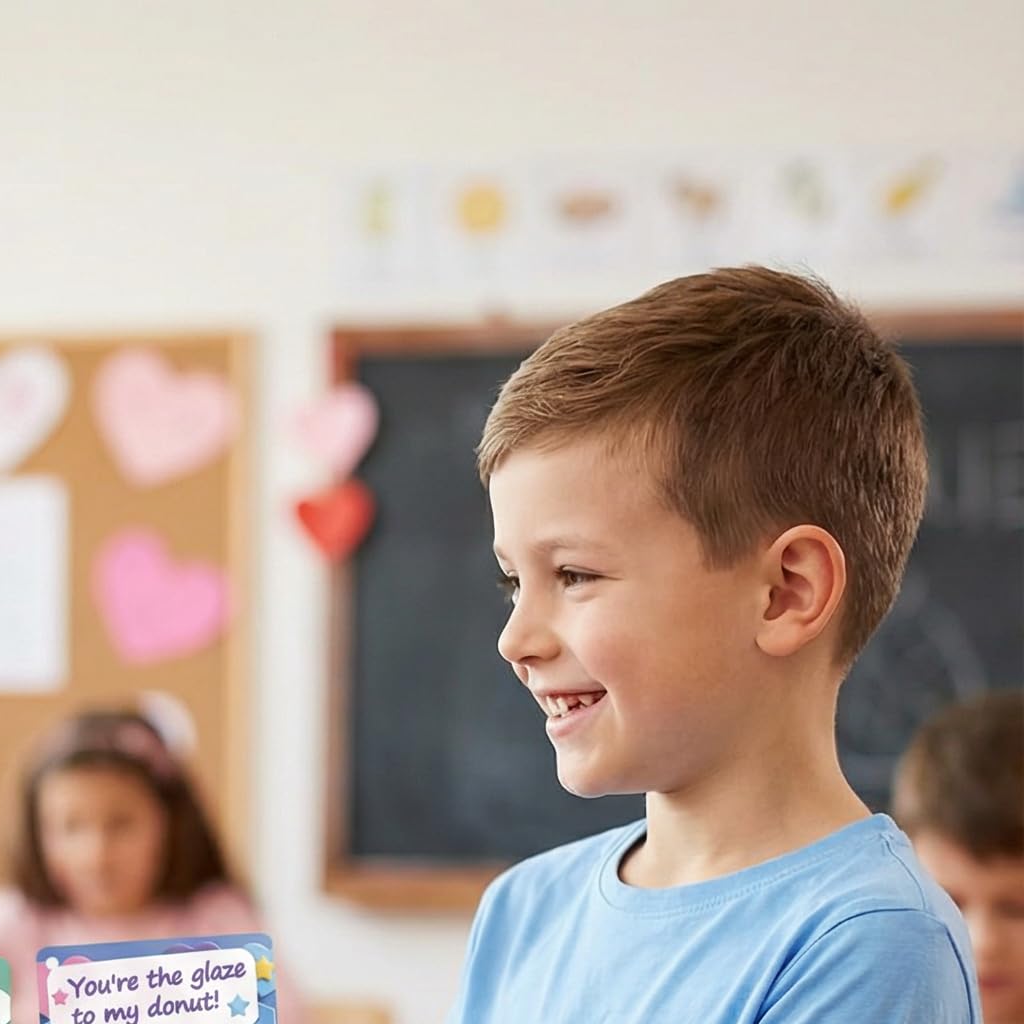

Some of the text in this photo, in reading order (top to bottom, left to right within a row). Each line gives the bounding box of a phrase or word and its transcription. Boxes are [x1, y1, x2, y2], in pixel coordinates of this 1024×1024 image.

[67, 959, 247, 998] You're the glaze
[147, 990, 220, 1017] donut!
